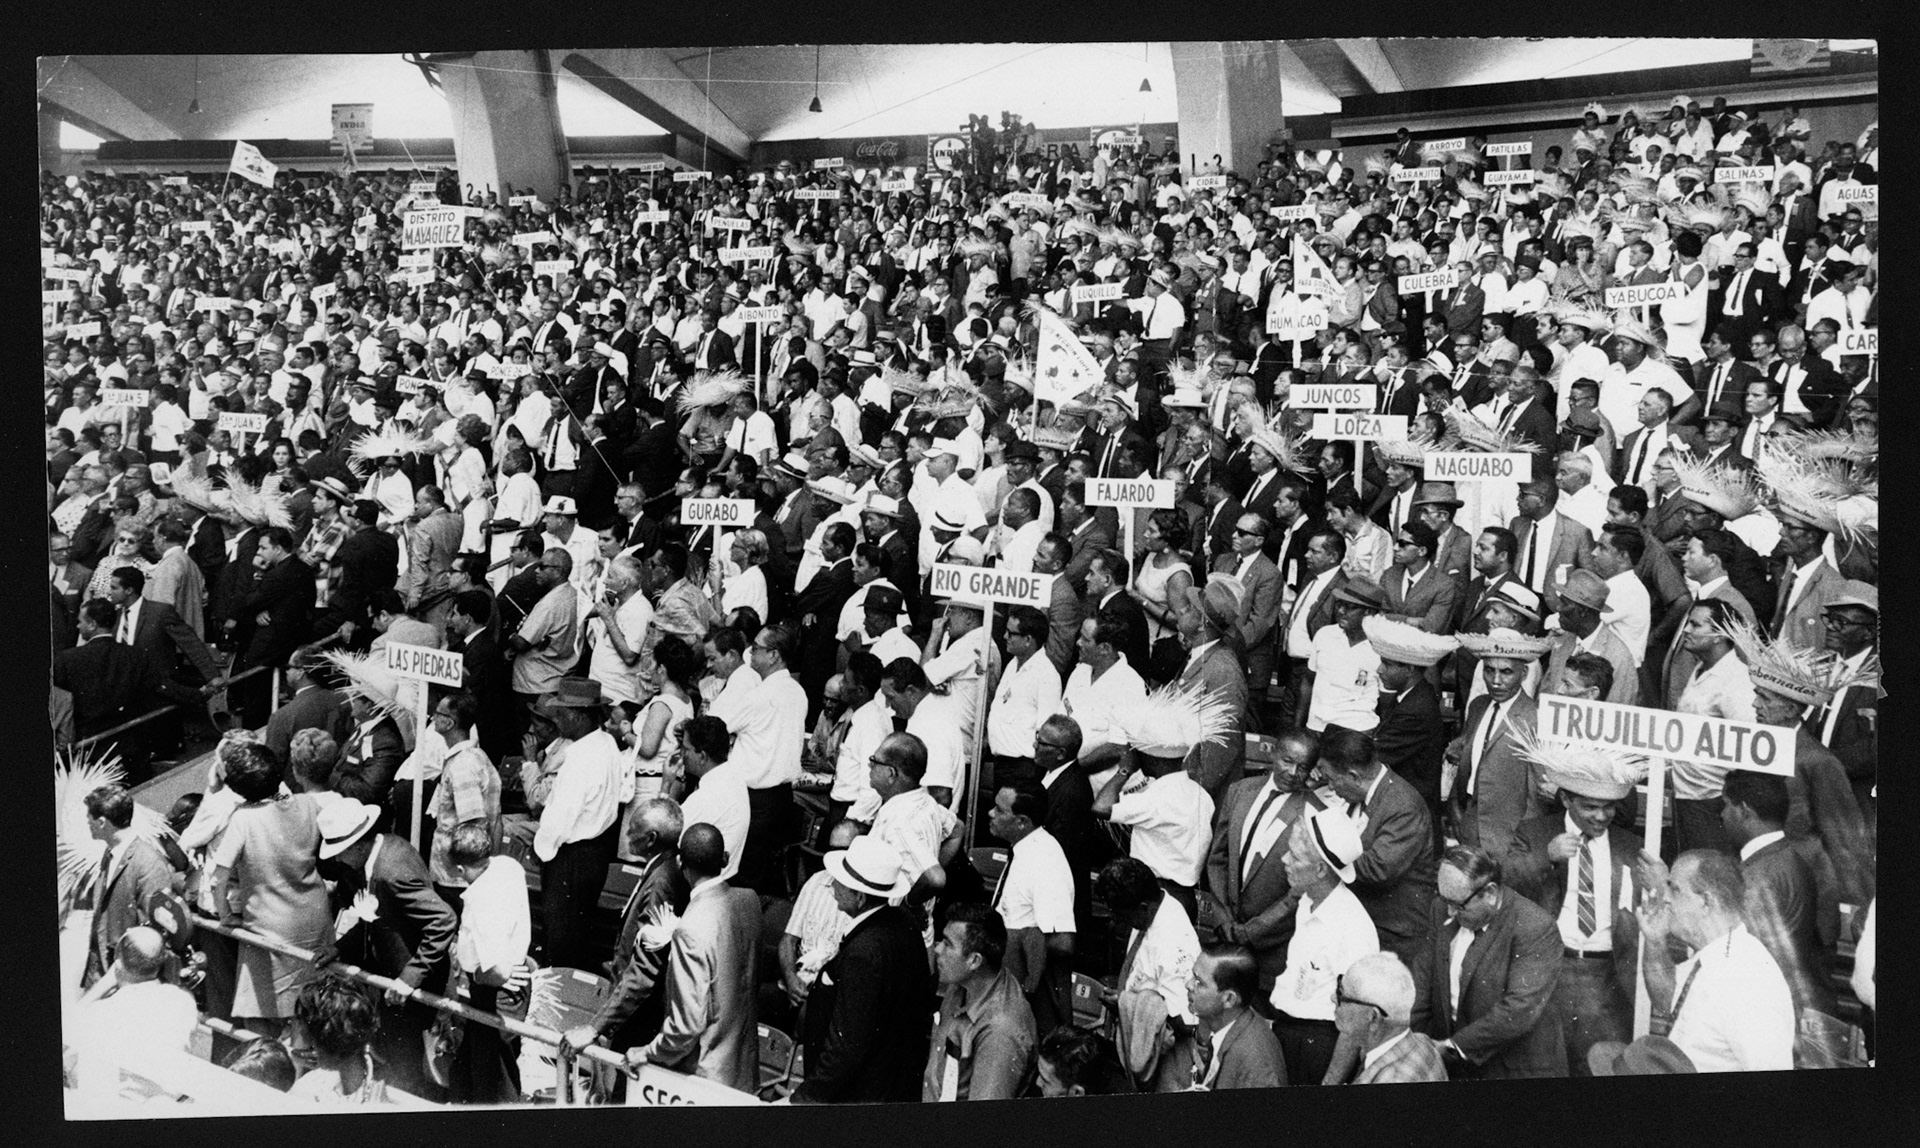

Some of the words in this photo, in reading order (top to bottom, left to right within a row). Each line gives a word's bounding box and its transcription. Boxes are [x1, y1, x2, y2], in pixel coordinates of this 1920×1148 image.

[1429, 139, 1463, 151] ARROYO
[1491, 144, 1528, 154] PATILLAS
[1397, 169, 1441, 180] NARANJITO
[1488, 173, 1528, 183] GUAYAMA
[1718, 168, 1765, 180] SALINAS
[1837, 187, 1875, 201] AGUAS
[410, 212, 455, 224] DISTRITO
[1278, 207, 1307, 218] CAYEY
[404, 225, 460, 245] MAYAGUEZ
[1404, 274, 1454, 291] CULEBRA
[1077, 286, 1117, 299] LUQUILLO
[1609, 286, 1677, 305] YABUCOA
[739, 308, 779, 321] AIBONITO
[1270, 314, 1322, 330] HUMCAO
[1302, 388, 1361, 404] JUNCOS
[1334, 418, 1383, 436] LOIZA
[1434, 457, 1513, 477] NAGUABO
[1097, 483, 1155, 502] FAJARDO
[688, 502, 738, 521] GURABO
[935, 569, 961, 592] RIO
[970, 573, 1040, 600] GRANDE
[388, 652, 408, 672] LAS
[412, 652, 460, 681] PIEDRAS
[1548, 700, 1684, 753] TRUJILLO
[1694, 721, 1776, 767] ALTO
